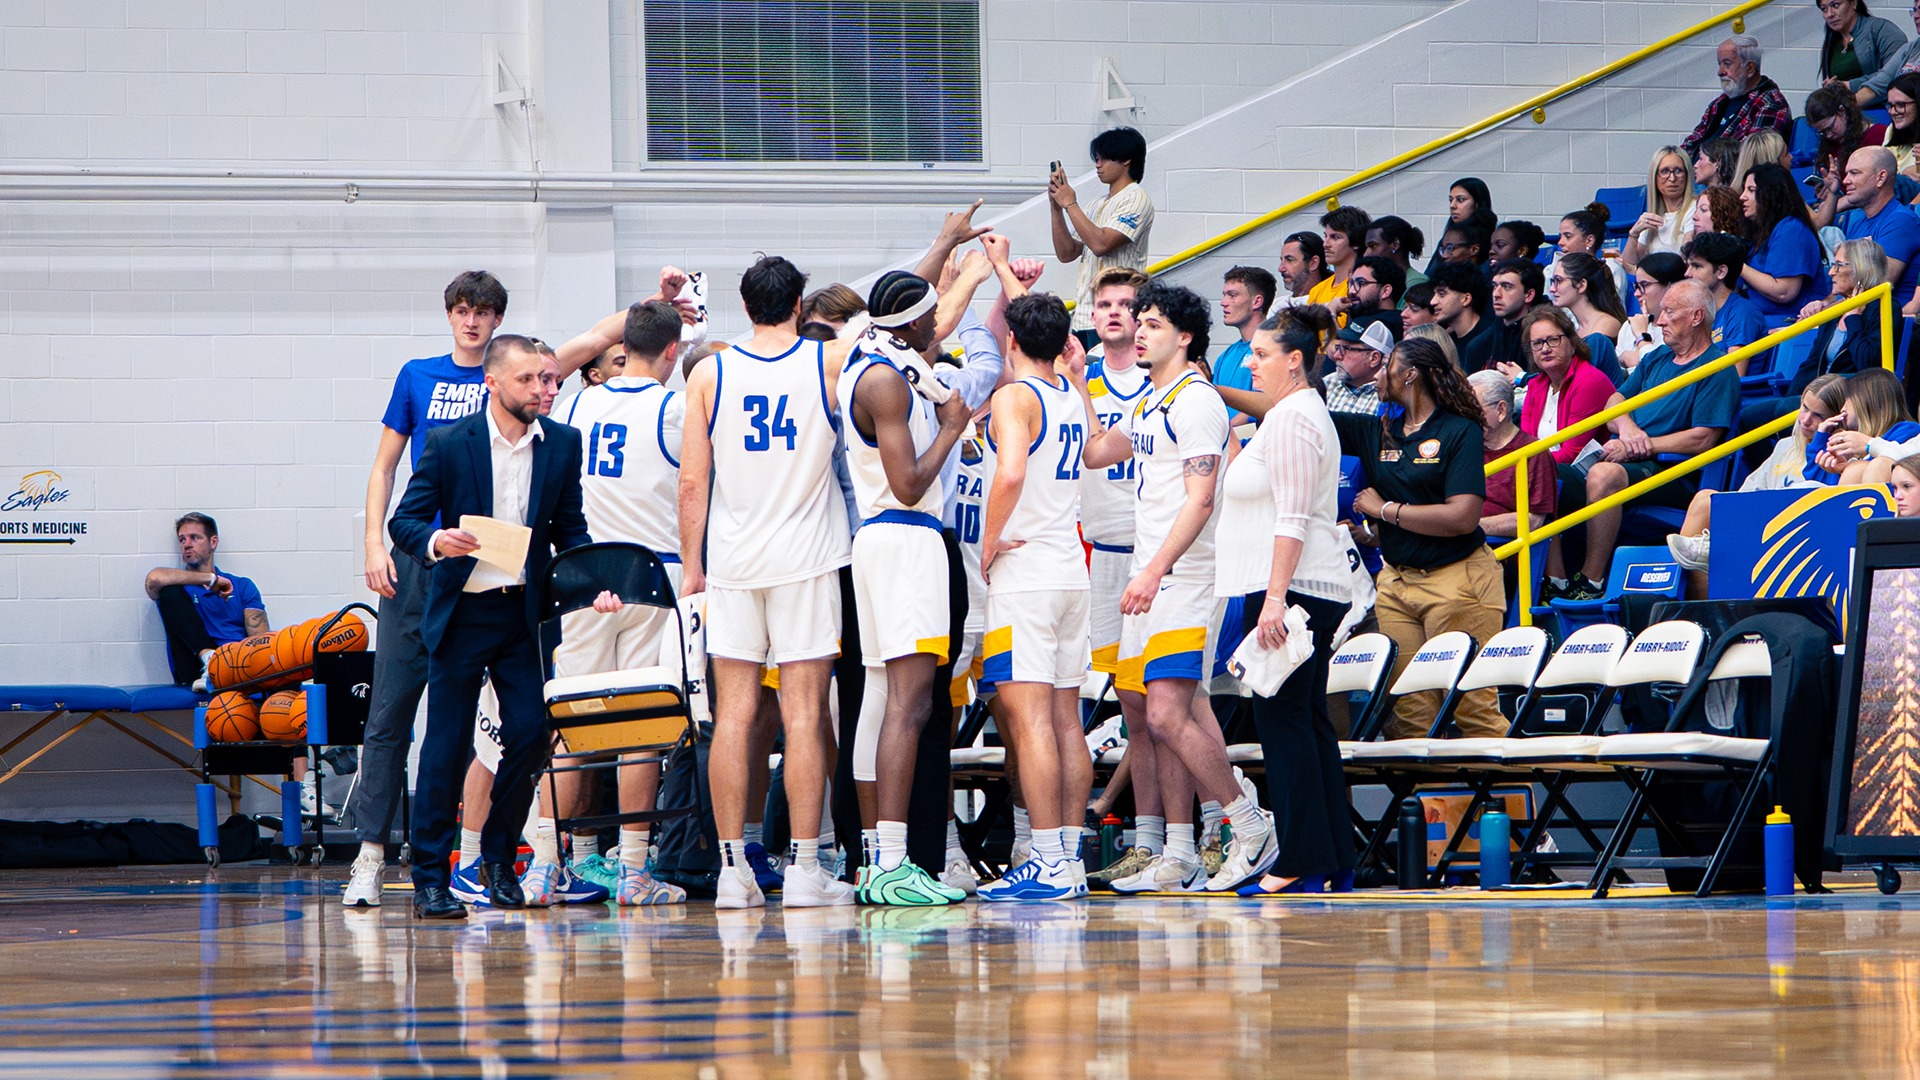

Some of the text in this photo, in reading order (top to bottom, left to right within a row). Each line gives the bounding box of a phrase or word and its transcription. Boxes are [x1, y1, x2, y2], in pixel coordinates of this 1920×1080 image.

[743, 395, 797, 451] 34
[587, 421, 628, 478] 13
[1055, 423, 1083, 480] 22
[1, 487, 70, 511] Eagles
[0, 522, 87, 534] ORTS MEDICINE
[319, 628, 357, 649] Wilson
[1480, 644, 1534, 657] EMBRY-RIDDLE
[1562, 642, 1614, 654] EMBRY-RIDDLE
[1634, 640, 1690, 652] EMBRY-RIDDLE
[1333, 652, 1376, 664] EMBRY-RIDDLE
[1414, 649, 1459, 662] EMBRY-RIDDLE
